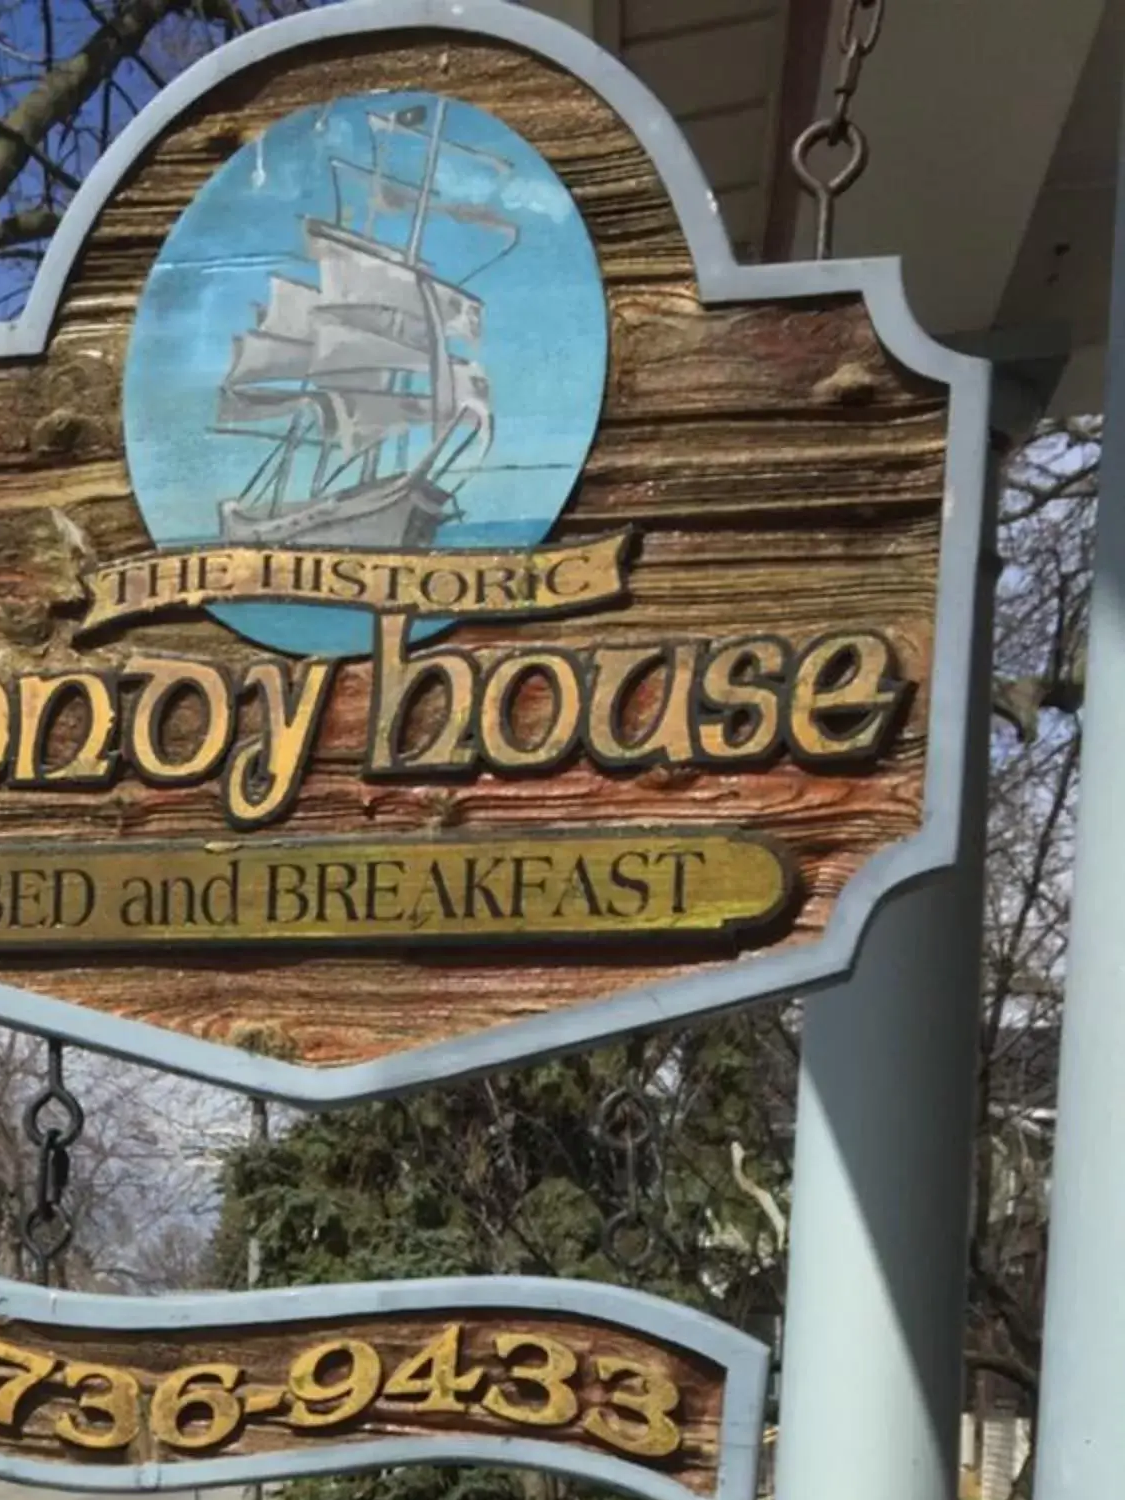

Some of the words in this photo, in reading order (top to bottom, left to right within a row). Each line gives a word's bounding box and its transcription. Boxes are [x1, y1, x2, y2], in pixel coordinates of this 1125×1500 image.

[103, 553, 236, 605] THE
[261, 552, 591, 604] HISTORIC
[120, 860, 240, 926] and
[265, 850, 705, 925] BREAKFAST
